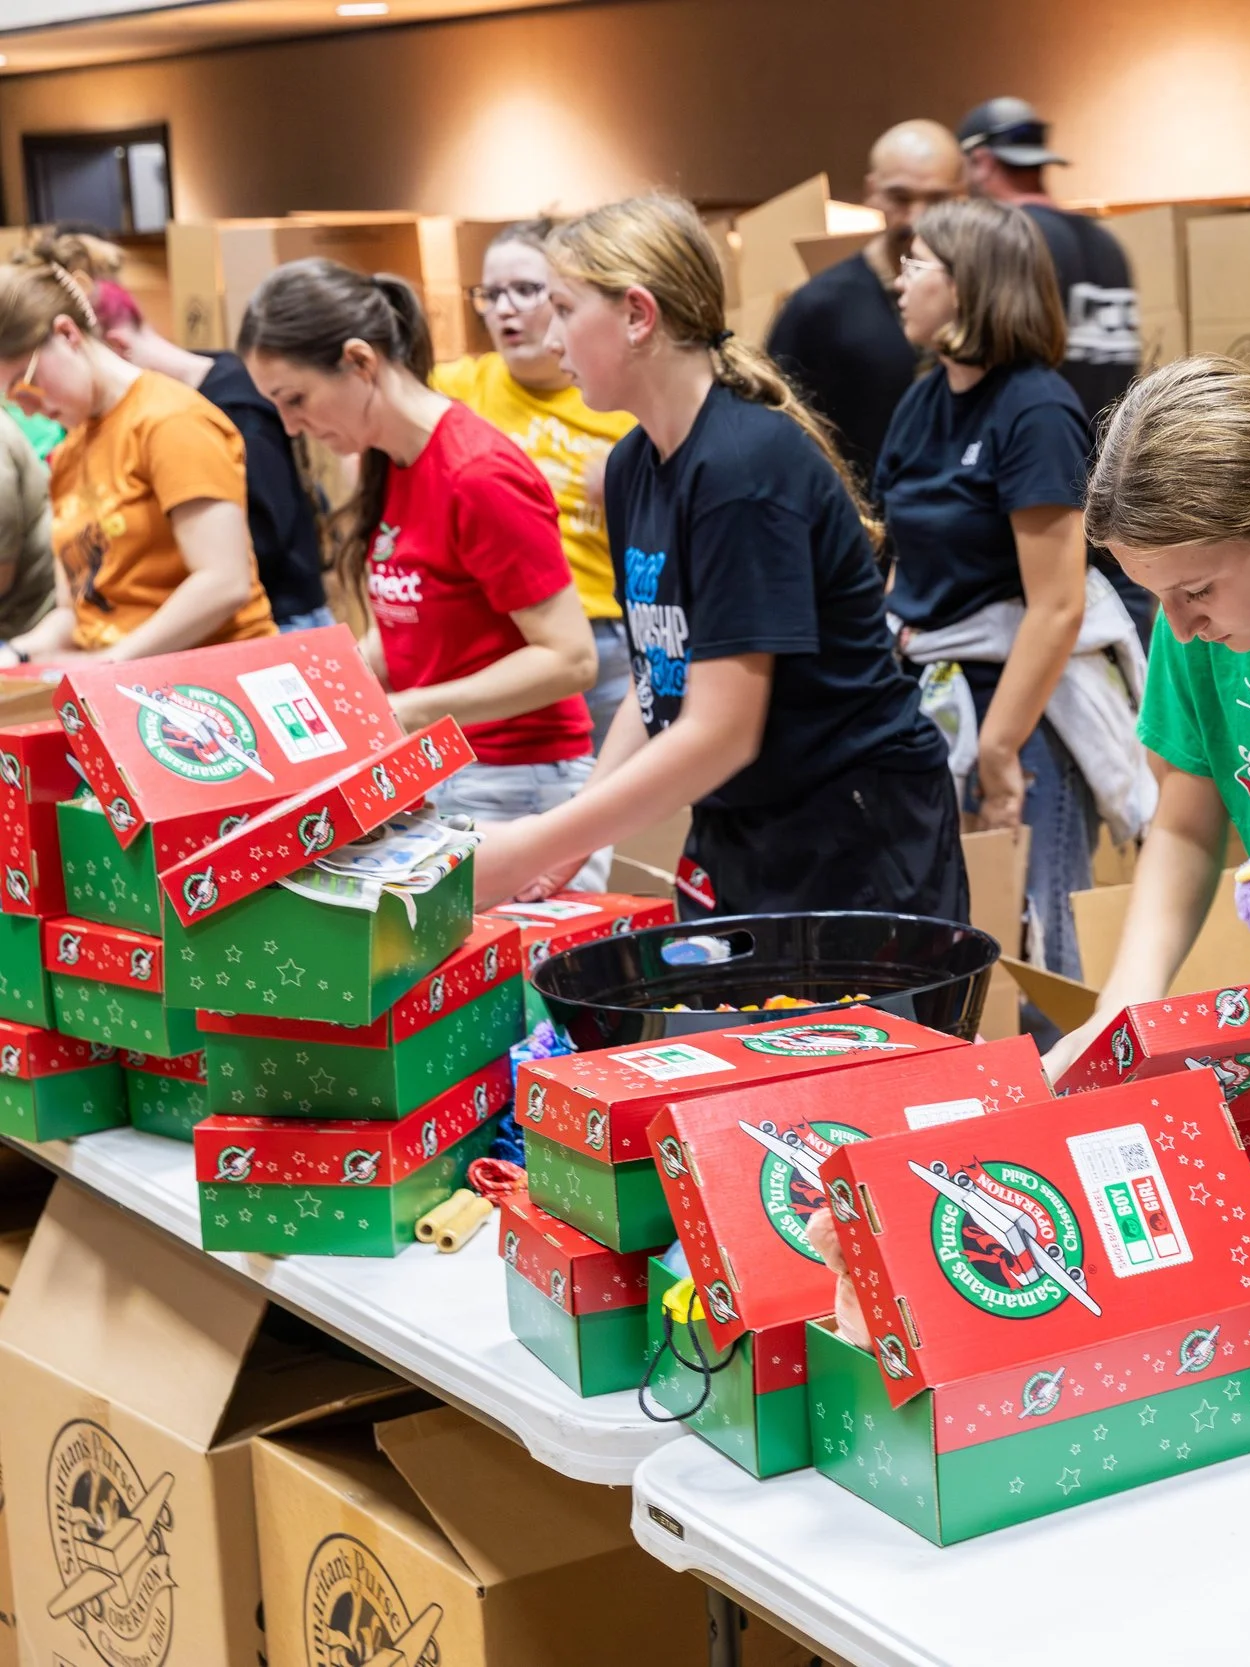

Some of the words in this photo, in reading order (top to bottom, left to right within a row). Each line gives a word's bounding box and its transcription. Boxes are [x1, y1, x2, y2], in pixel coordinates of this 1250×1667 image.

[767, 1161, 788, 1217] Purse
[975, 1172, 1055, 1240] OPERATION
[1000, 1167, 1040, 1191] Child
[1108, 1187, 1134, 1217] BOY
[1136, 1177, 1161, 1213] GIRL
[939, 1202, 960, 1263] Purse
[1039, 1185, 1079, 1252] Christmas
[951, 1261, 1062, 1309] Samaritan's
[352, 1548, 401, 1633] Purse
